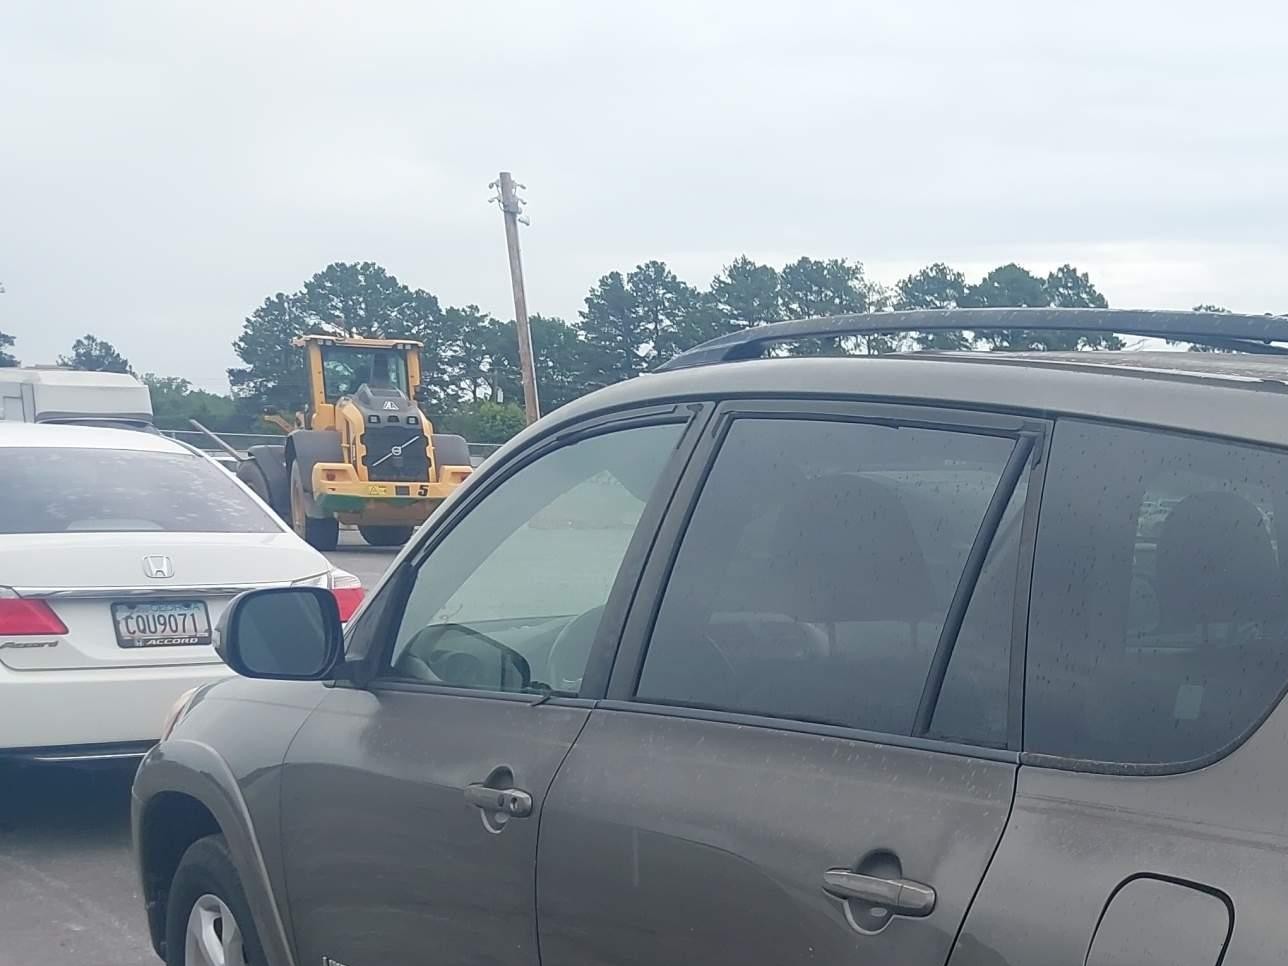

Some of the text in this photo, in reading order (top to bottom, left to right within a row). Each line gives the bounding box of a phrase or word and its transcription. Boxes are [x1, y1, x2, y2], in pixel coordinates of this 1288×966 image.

[418, 485, 429, 496] 5
[124, 613, 198, 635] CQU9071
[146, 637, 199, 646] ACCORD
